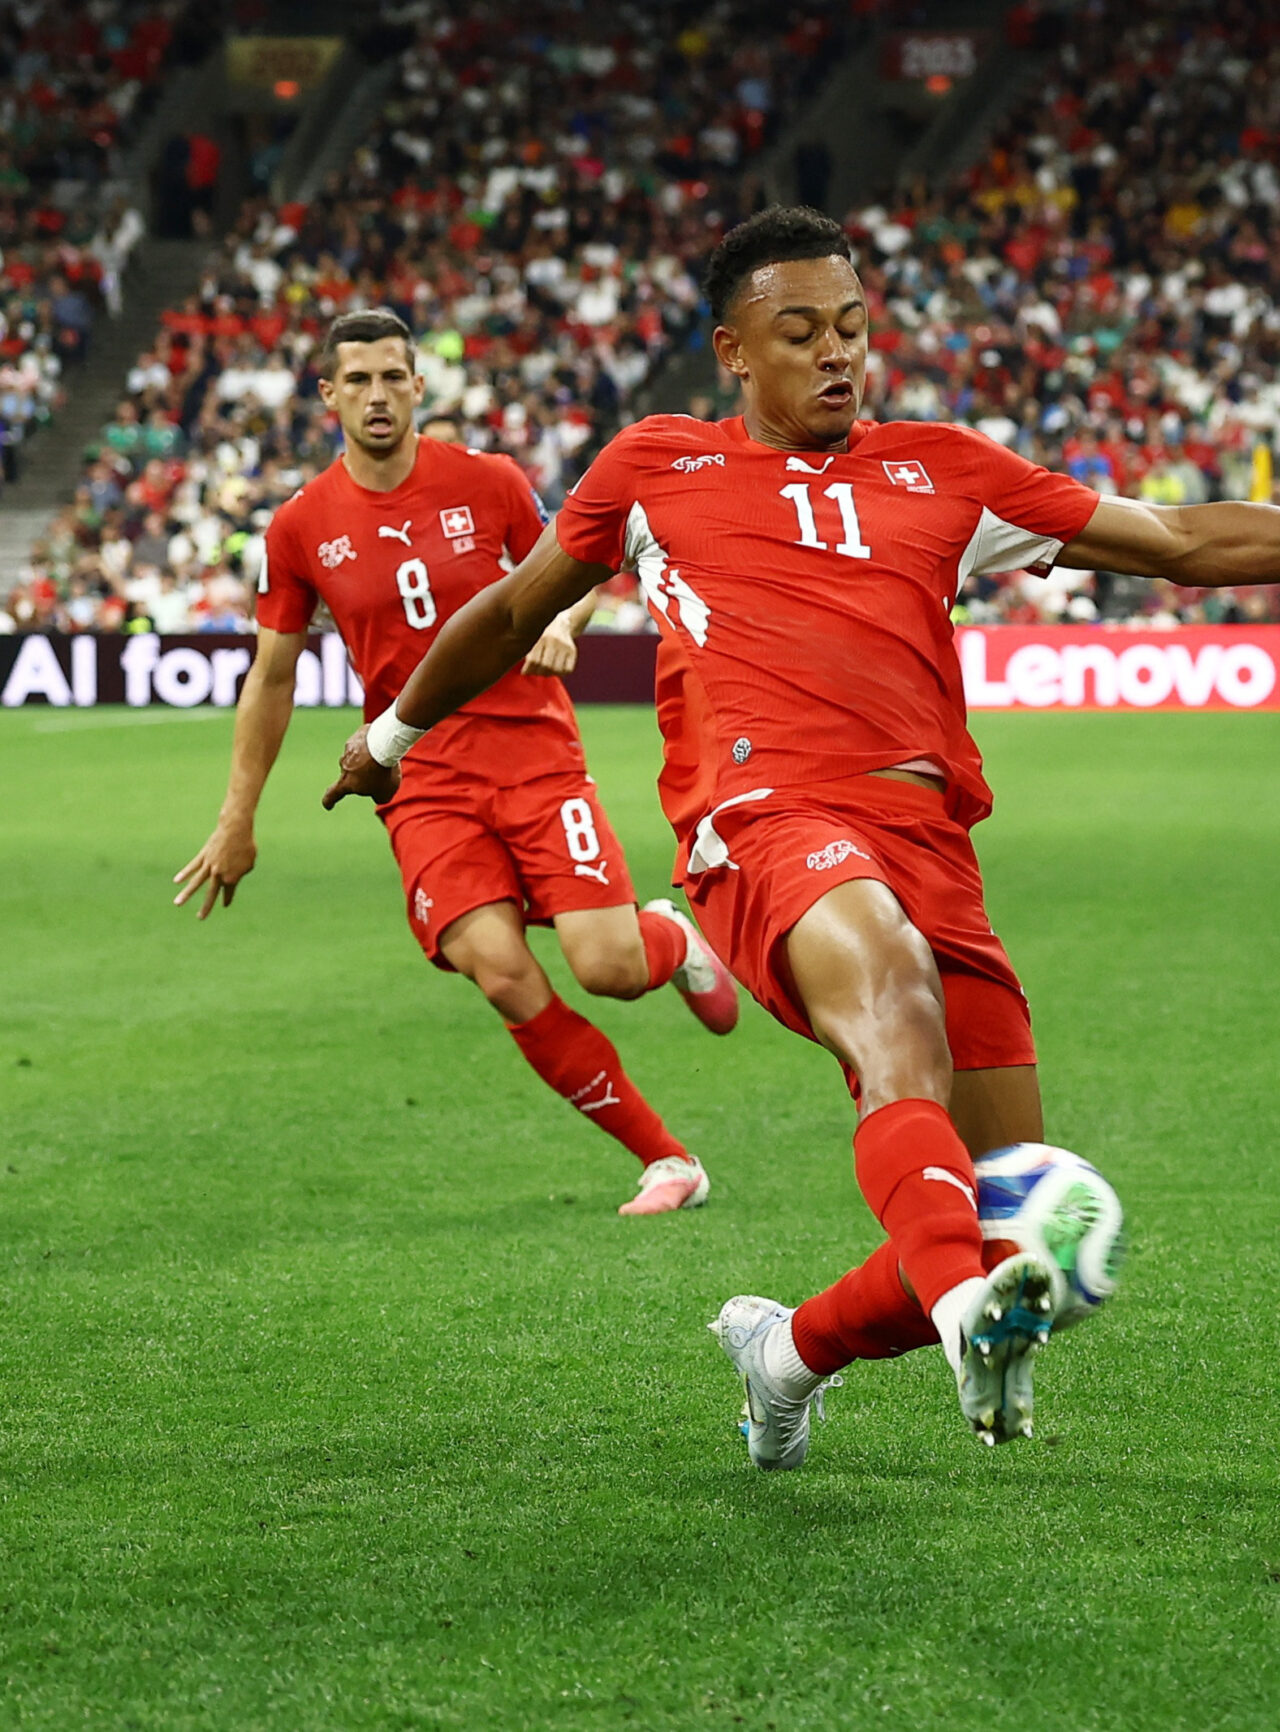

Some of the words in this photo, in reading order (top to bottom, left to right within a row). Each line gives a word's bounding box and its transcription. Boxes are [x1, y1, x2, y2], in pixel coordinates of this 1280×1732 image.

[779, 483, 871, 559] 11
[396, 558, 438, 630] 8
[0, 634, 97, 707] AI
[120, 632, 251, 707] for
[961, 630, 1276, 707] Lenovo
[560, 798, 601, 863] 8
